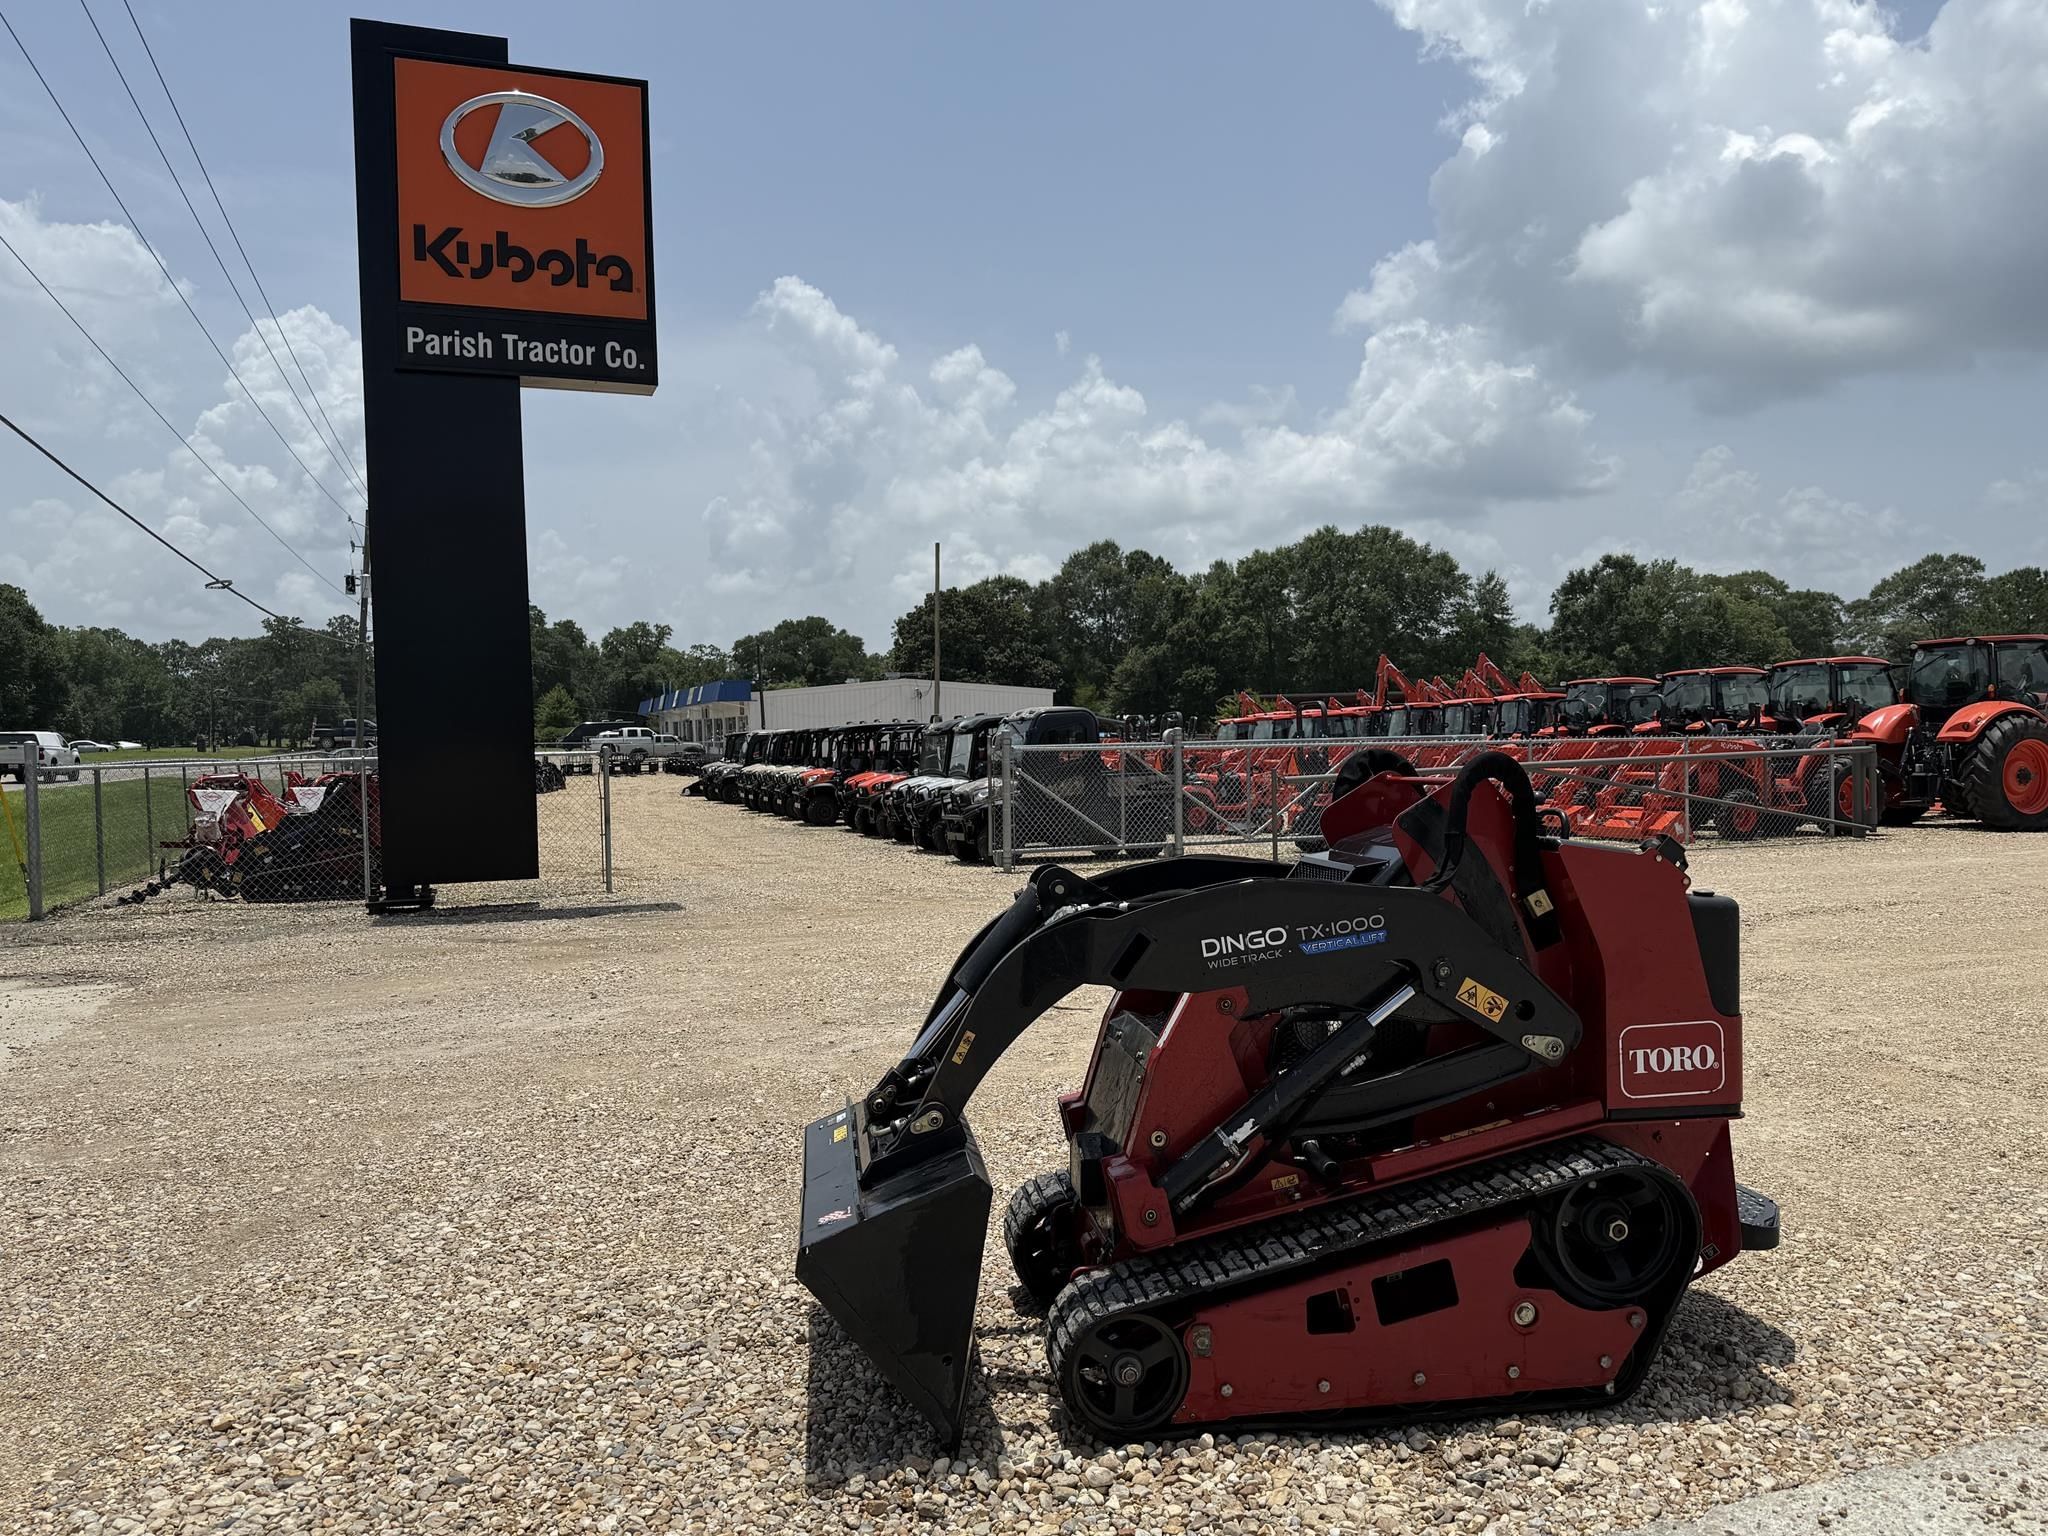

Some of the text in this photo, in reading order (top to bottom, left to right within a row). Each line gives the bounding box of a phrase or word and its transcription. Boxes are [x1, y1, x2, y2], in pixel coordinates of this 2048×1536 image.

[413, 224, 633, 293] Kubota
[406, 326, 645, 370] Parish Tractor Co.
[1201, 927, 1287, 957] DINGO
[1302, 932, 1386, 953] VERTICAL LIFT
[1207, 949, 1283, 969] WIDE TRACK
[1629, 1044, 1715, 1074] TORO
